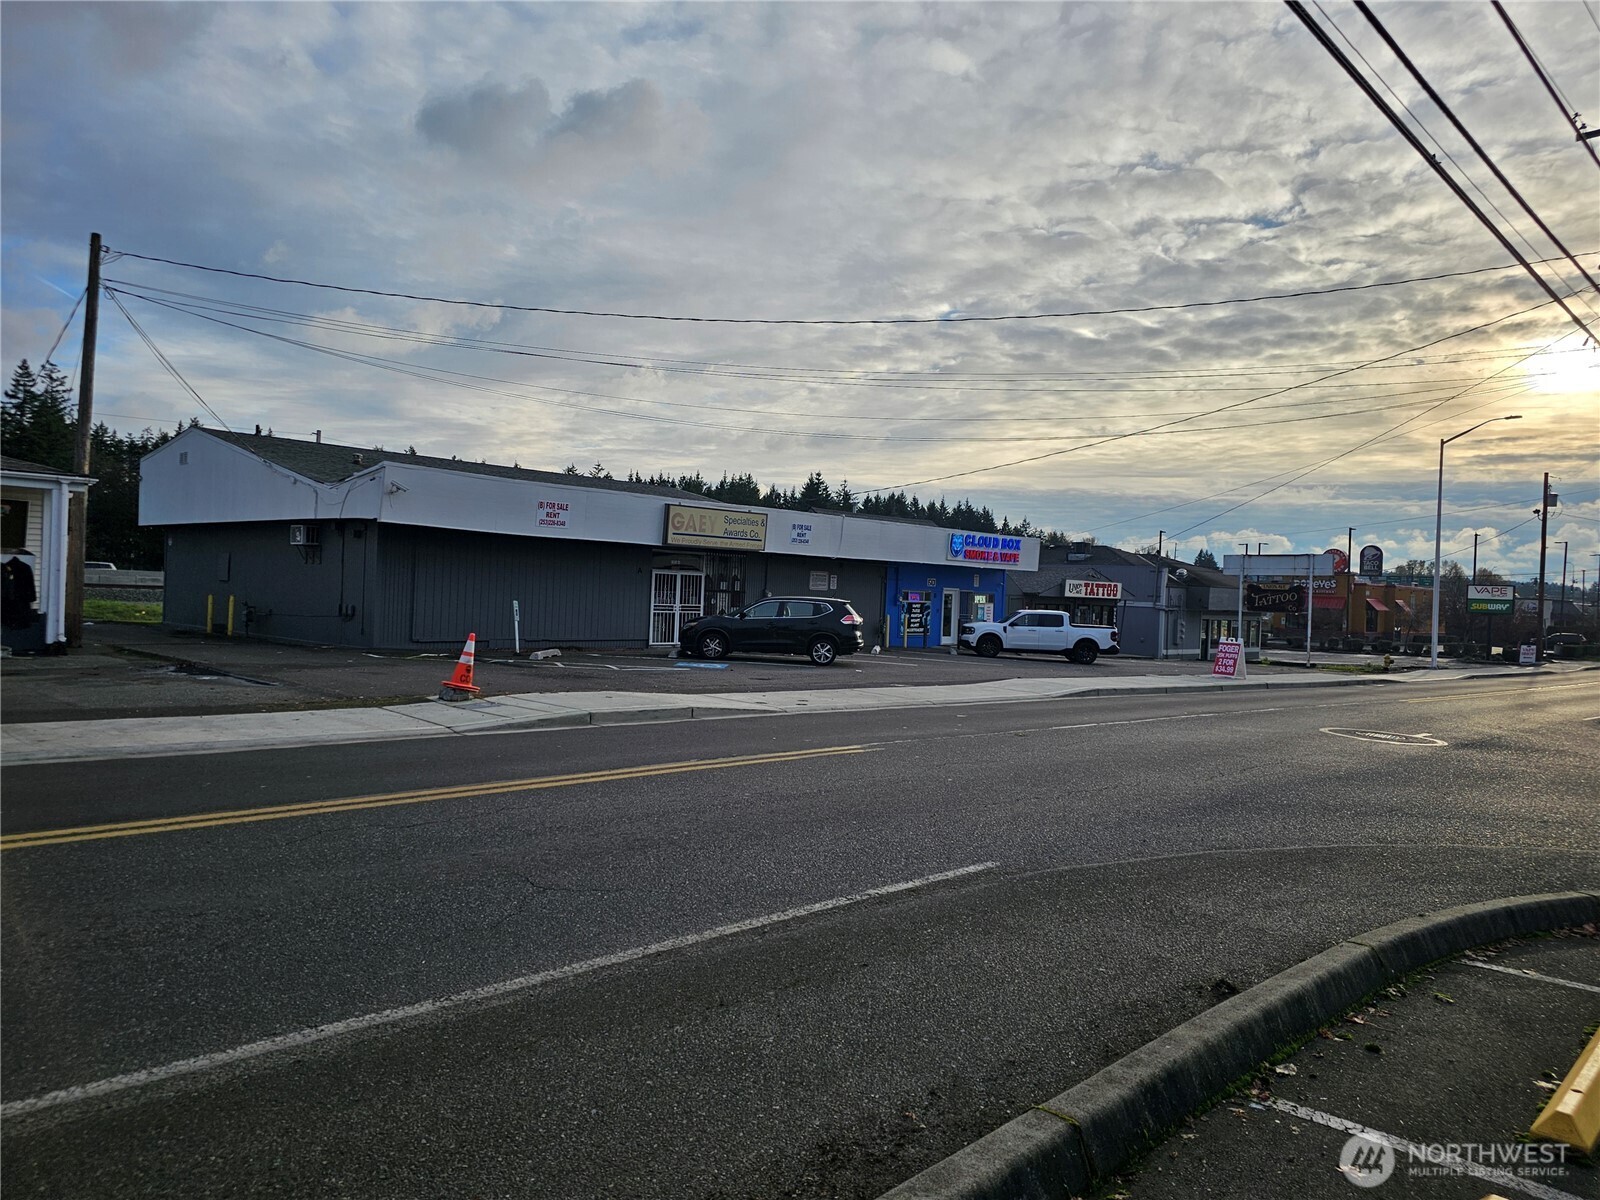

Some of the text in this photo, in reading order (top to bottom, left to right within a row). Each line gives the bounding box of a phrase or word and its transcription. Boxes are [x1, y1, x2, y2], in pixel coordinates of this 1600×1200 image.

[546, 501, 556, 510] FOR
[556, 502, 570, 511] SALE
[545, 511, 560, 519] RENT
[723, 515, 767, 527] Specialties &
[722, 527, 761, 538] Awards Co.
[964, 534, 1022, 551] CLOUD BOX
[964, 549, 1020, 563] SMOKE & VAPE
[1083, 582, 1119, 598] TATTOO
[1474, 586, 1508, 595] VAPE
[1251, 592, 1298, 607] TATTOO
[1470, 603, 1510, 611] SUBWAY
[1218, 644, 1240, 653] FOGER
[1222, 658, 1235, 666] FOR
[1214, 665, 1235, 674] $34.99
